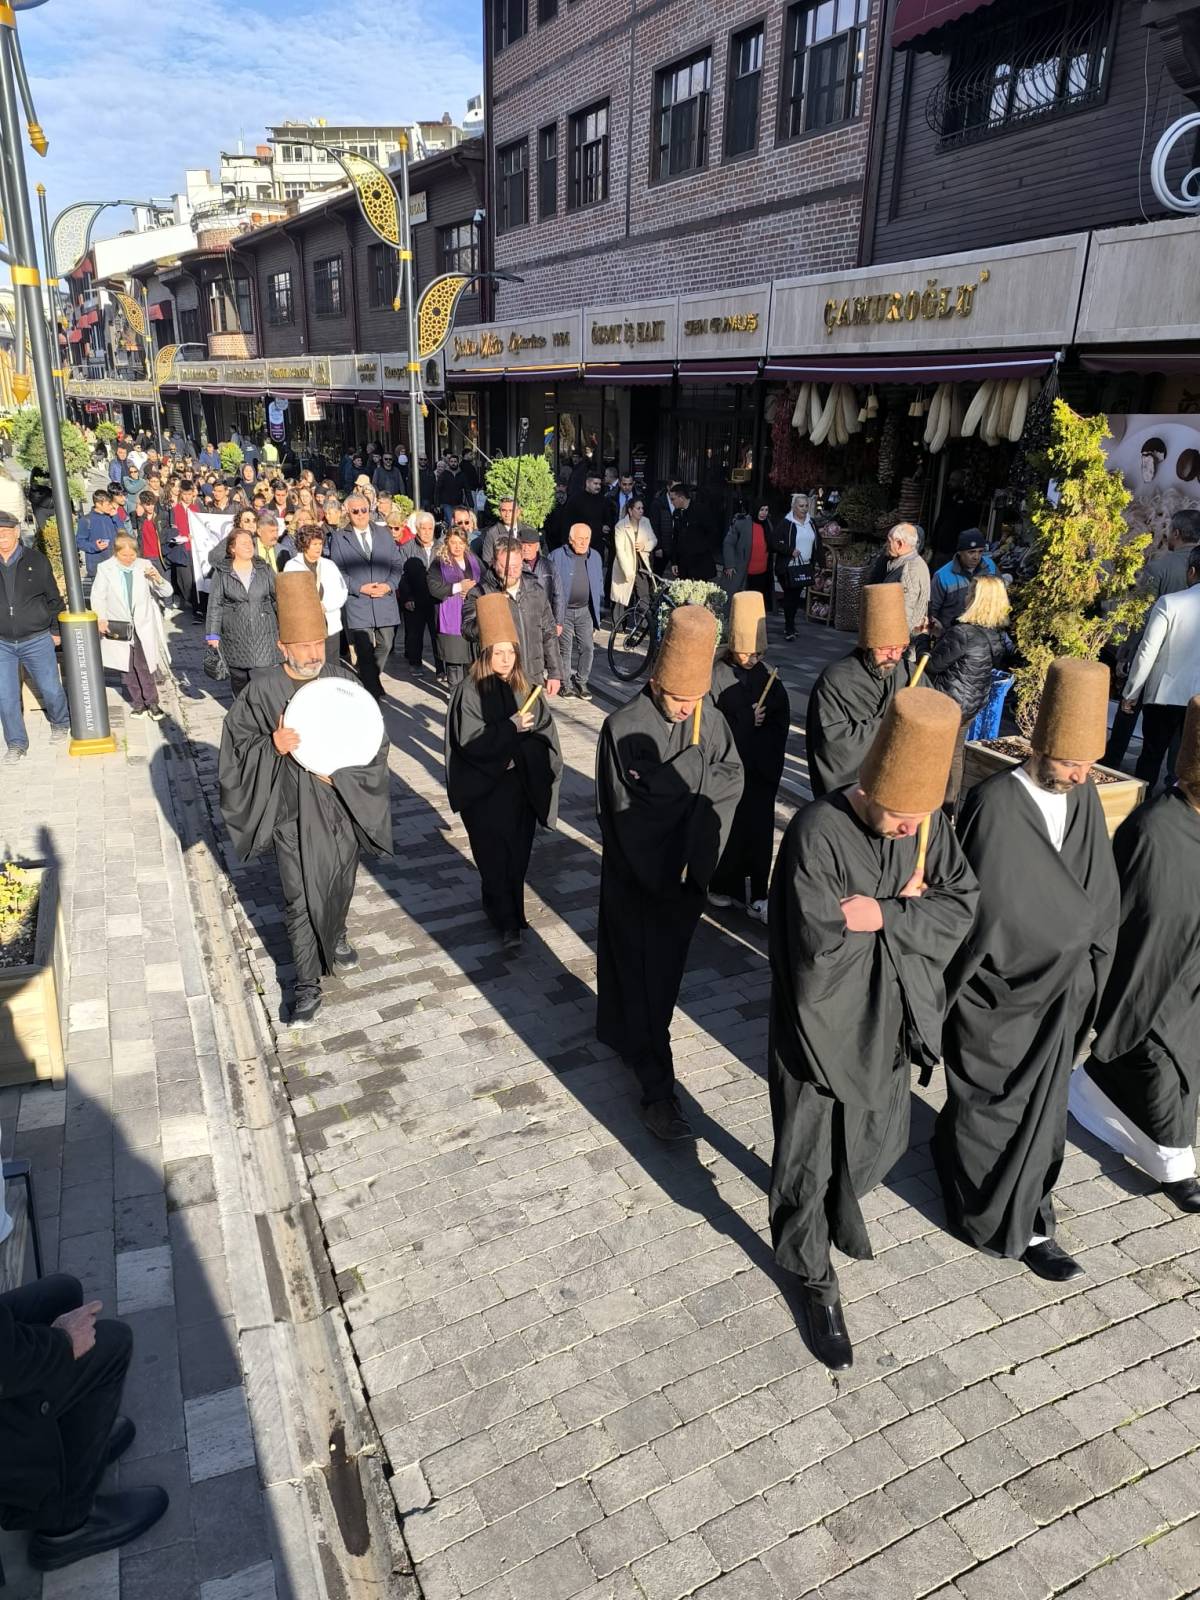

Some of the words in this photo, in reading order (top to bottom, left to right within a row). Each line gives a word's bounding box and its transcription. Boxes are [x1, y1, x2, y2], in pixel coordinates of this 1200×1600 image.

[823, 279, 977, 336] ÇAMUROĞLU
[75, 628, 87, 668] BELEDİYESİ
[80, 670, 95, 731] AFYONKARAHİSAR
